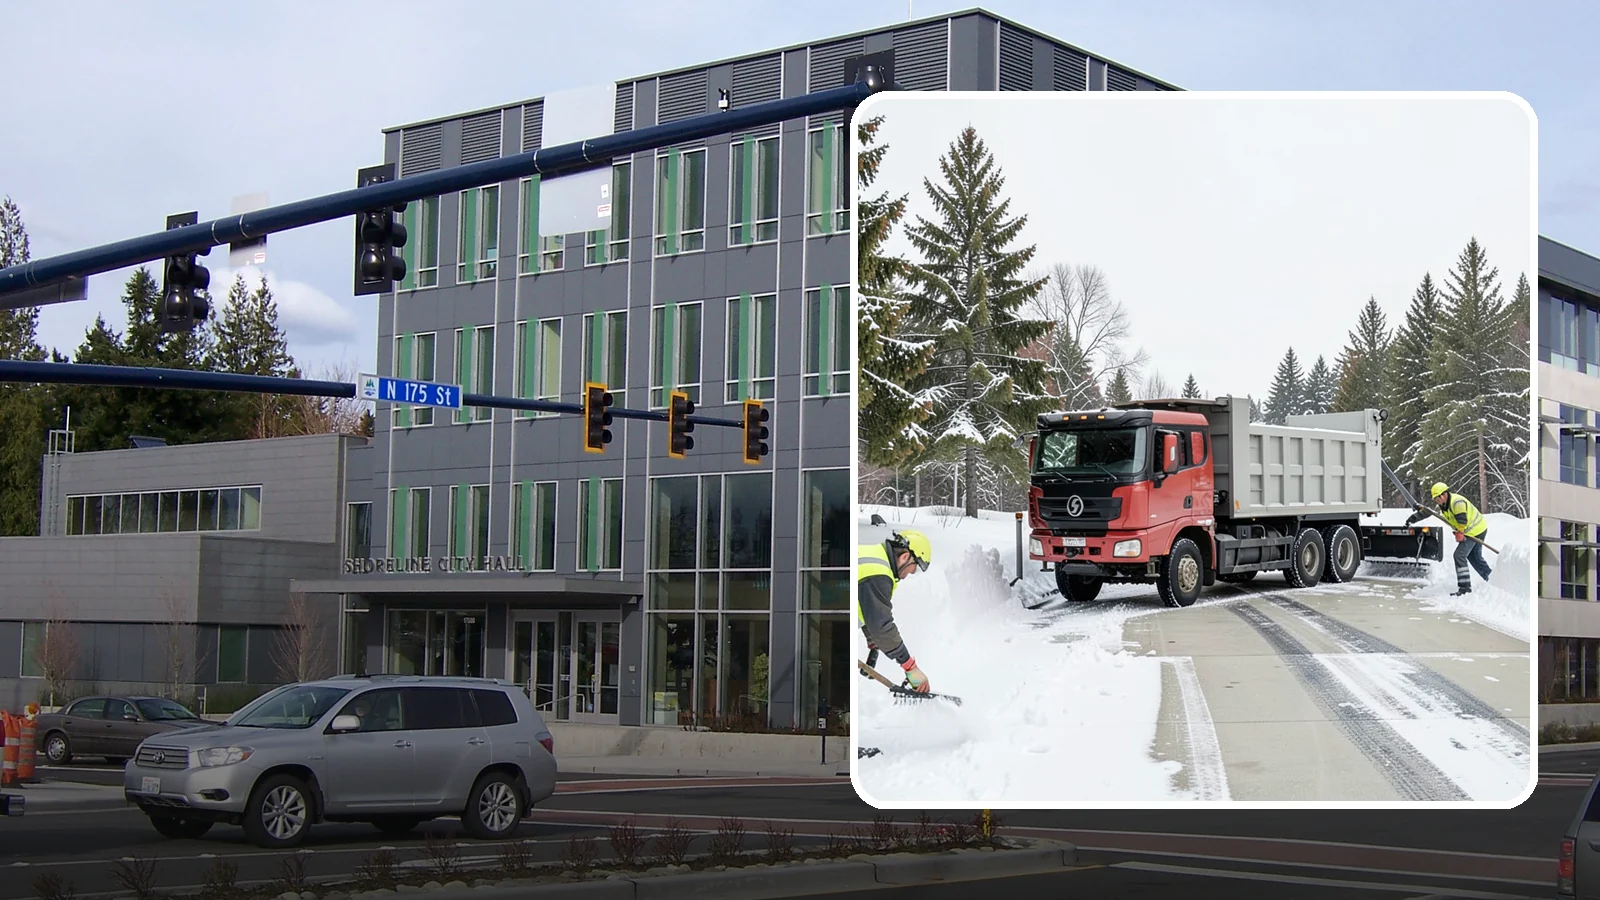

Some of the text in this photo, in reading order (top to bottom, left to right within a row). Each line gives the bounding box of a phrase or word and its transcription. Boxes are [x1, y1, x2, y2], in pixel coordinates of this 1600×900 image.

[387, 381, 451, 405] N 175 St
[344, 556, 525, 573] SHORELINE CITY HALL
